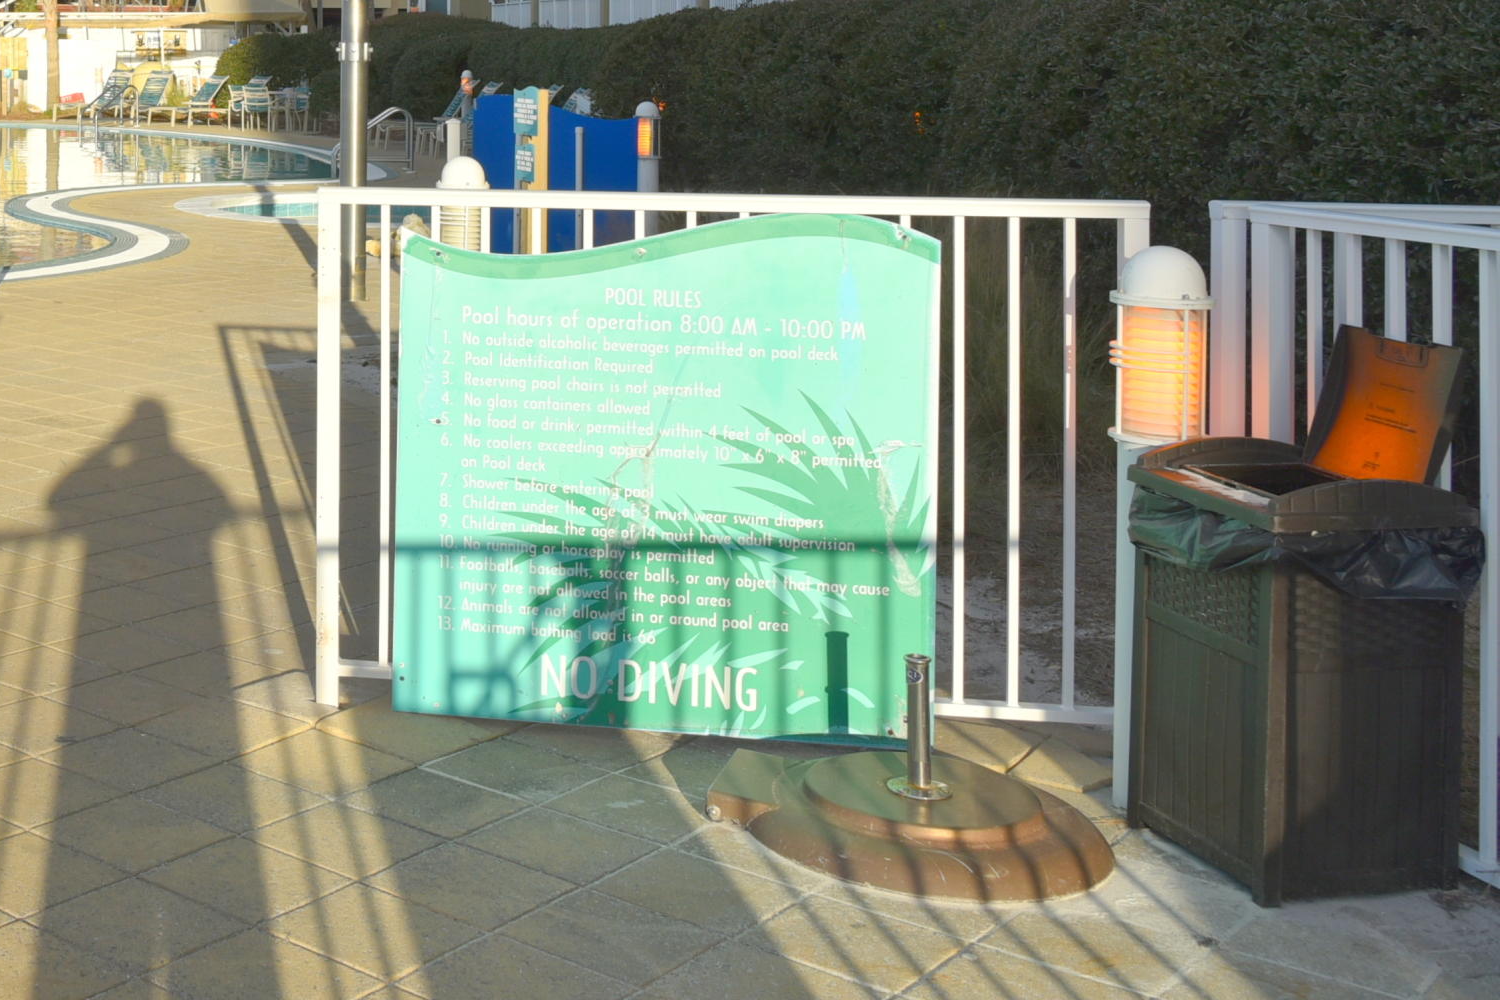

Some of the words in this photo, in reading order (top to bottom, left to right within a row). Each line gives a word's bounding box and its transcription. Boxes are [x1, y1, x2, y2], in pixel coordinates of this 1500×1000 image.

[605, 288, 646, 306] POOL
[654, 290, 702, 308] RULES
[462, 306, 500, 325] Pool
[507, 307, 552, 327] hours
[560, 309, 579, 328] of
[586, 312, 672, 333] operation
[680, 315, 723, 334] 8:00
[732, 318, 757, 336] AM
[781, 319, 833, 339] 10:00
[841, 321, 866, 340] PM
[443, 330, 452, 344] 1.
[462, 332, 480, 345] No
[486, 333, 533, 347] outside
[539, 335, 597, 350] alcoholic
[603, 337, 670, 357] beverages
[676, 343, 743, 357] permitted
[749, 348, 765, 358] on
[772, 346, 801, 361] pool
[808, 346, 838, 360] deck
[442, 351, 454, 365] 2.
[465, 352, 492, 366] Pool
[500, 353, 588, 370] Identification
[595, 357, 653, 374] Required
[442, 371, 452, 384] 3.
[464, 372, 526, 391] Reserving
[532, 376, 560, 391] pool
[567, 376, 604, 392] chairs
[610, 382, 619, 392] is
[626, 379, 647, 393] not
[441, 393, 452, 405] 4.
[464, 393, 481, 405] No
[487, 394, 517, 411] glass
[524, 397, 591, 411] containers
[597, 398, 650, 415] allowed
[441, 412, 452, 426] 5.
[464, 414, 481, 427] No
[488, 415, 516, 429] food
[522, 420, 535, 430] or
[586, 420, 653, 437] permitted
[660, 422, 702, 439] within
[708, 425, 717, 439] 4
[724, 425, 750, 441] feet
[756, 427, 771, 442] of
[775, 429, 806, 445] pool
[812, 435, 826, 444] or
[832, 435, 855, 448] spa
[441, 434, 452, 447] 6.
[464, 434, 481, 448] No
[487, 436, 532, 450] coolers
[538, 439, 604, 457] exceeding
[609, 443, 708, 461] approimately
[742, 452, 750, 461] x
[777, 455, 785, 464] x
[812, 453, 882, 468] permitted
[461, 457, 476, 468] on
[484, 455, 510, 469] Pool
[516, 456, 547, 471] deck
[440, 473, 451, 487] 7.
[462, 474, 508, 490] Shower
[516, 477, 556, 493] before
[563, 481, 619, 500] entering
[624, 486, 654, 500] pool
[439, 493, 452, 507] 8.
[462, 494, 516, 511] Children
[522, 499, 559, 513] under
[565, 500, 586, 516] the
[592, 507, 615, 519] age
[621, 506, 636, 519] of
[642, 505, 649, 520] 3
[655, 508, 687, 521] must
[694, 512, 727, 524] wear
[733, 515, 769, 528] swim
[775, 514, 824, 531] diapers
[439, 515, 451, 528] 9.
[462, 515, 515, 531] Children
[522, 519, 559, 534] under
[565, 521, 585, 536] the
[592, 526, 615, 540] age
[621, 526, 635, 539] of
[642, 526, 656, 539] 14
[662, 529, 693, 542] must
[700, 529, 732, 544] have
[738, 532, 772, 546] adult
[779, 538, 855, 552] supervision
[440, 535, 456, 548] 10.
[464, 536, 480, 549] No
[487, 541, 537, 556] running
[543, 544, 555, 554] or
[562, 541, 625, 561] horseplay
[631, 550, 640, 560] is
[647, 548, 714, 565] permitted
[439, 556, 453, 569] 11.
[459, 556, 523, 574] Footballs,
[529, 560, 592, 578] baseballs,
[599, 570, 638, 581] soccer
[644, 567, 679, 584] balls,
[686, 573, 700, 584] or
[706, 575, 730, 588] any
[735, 574, 776, 591] object
[784, 577, 811, 591] that
[817, 582, 847, 595] may
[853, 584, 889, 596] cause
[460, 580, 496, 594] injury
[502, 583, 523, 594] are
[529, 584, 550, 596] not
[557, 583, 609, 600] allowed
[615, 587, 627, 600] in
[634, 588, 655, 602] the
[661, 591, 690, 606] pool
[696, 596, 732, 607] areas
[438, 596, 455, 610] 12.
[461, 598, 512, 614] Animals
[519, 604, 539, 616] are
[545, 605, 566, 617] not
[573, 605, 626, 621] allowed
[632, 609, 643, 622] in
[650, 614, 664, 623] or
[670, 613, 716, 627] around
[723, 616, 752, 631] pool
[758, 621, 788, 632] area
[438, 616, 455, 631] 13.
[461, 618, 525, 635] Maximum
[532, 623, 581, 641] bathing
[588, 626, 616, 641] load
[623, 632, 631, 641] is
[638, 630, 655, 644] 66
[540, 654, 598, 700] NO
[618, 659, 757, 712] DIVING
